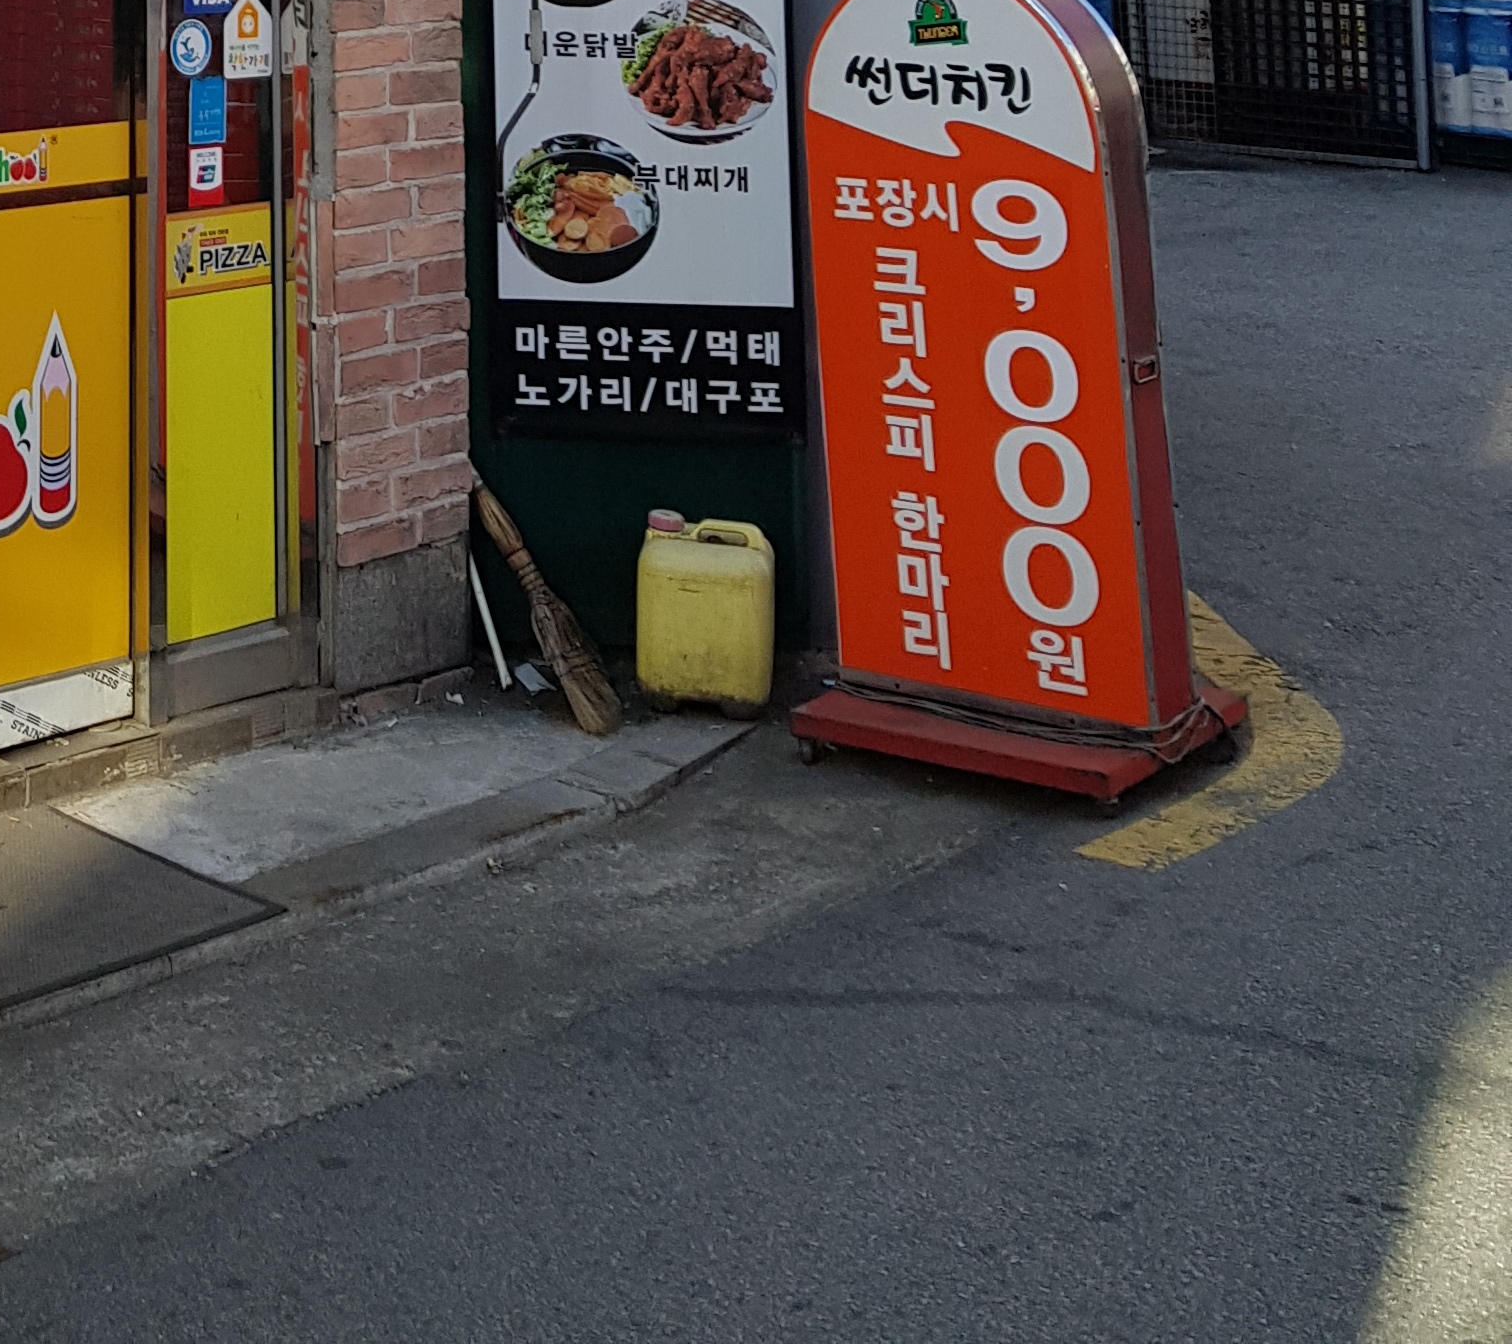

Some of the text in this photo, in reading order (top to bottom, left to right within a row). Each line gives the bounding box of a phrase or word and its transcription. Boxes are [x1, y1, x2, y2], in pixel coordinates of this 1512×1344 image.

[844, 55, 1033, 115] 썬더치킨
[633, 164, 750, 193] 부대찌개
[833, 176, 960, 233] 포장시
[199, 242, 270, 274] PIZZA
[514, 323, 782, 368] 마른안주/먹태
[514, 374, 784, 415] 노가리/대구포
[873, 246, 952, 672] 크리스피 한마리
